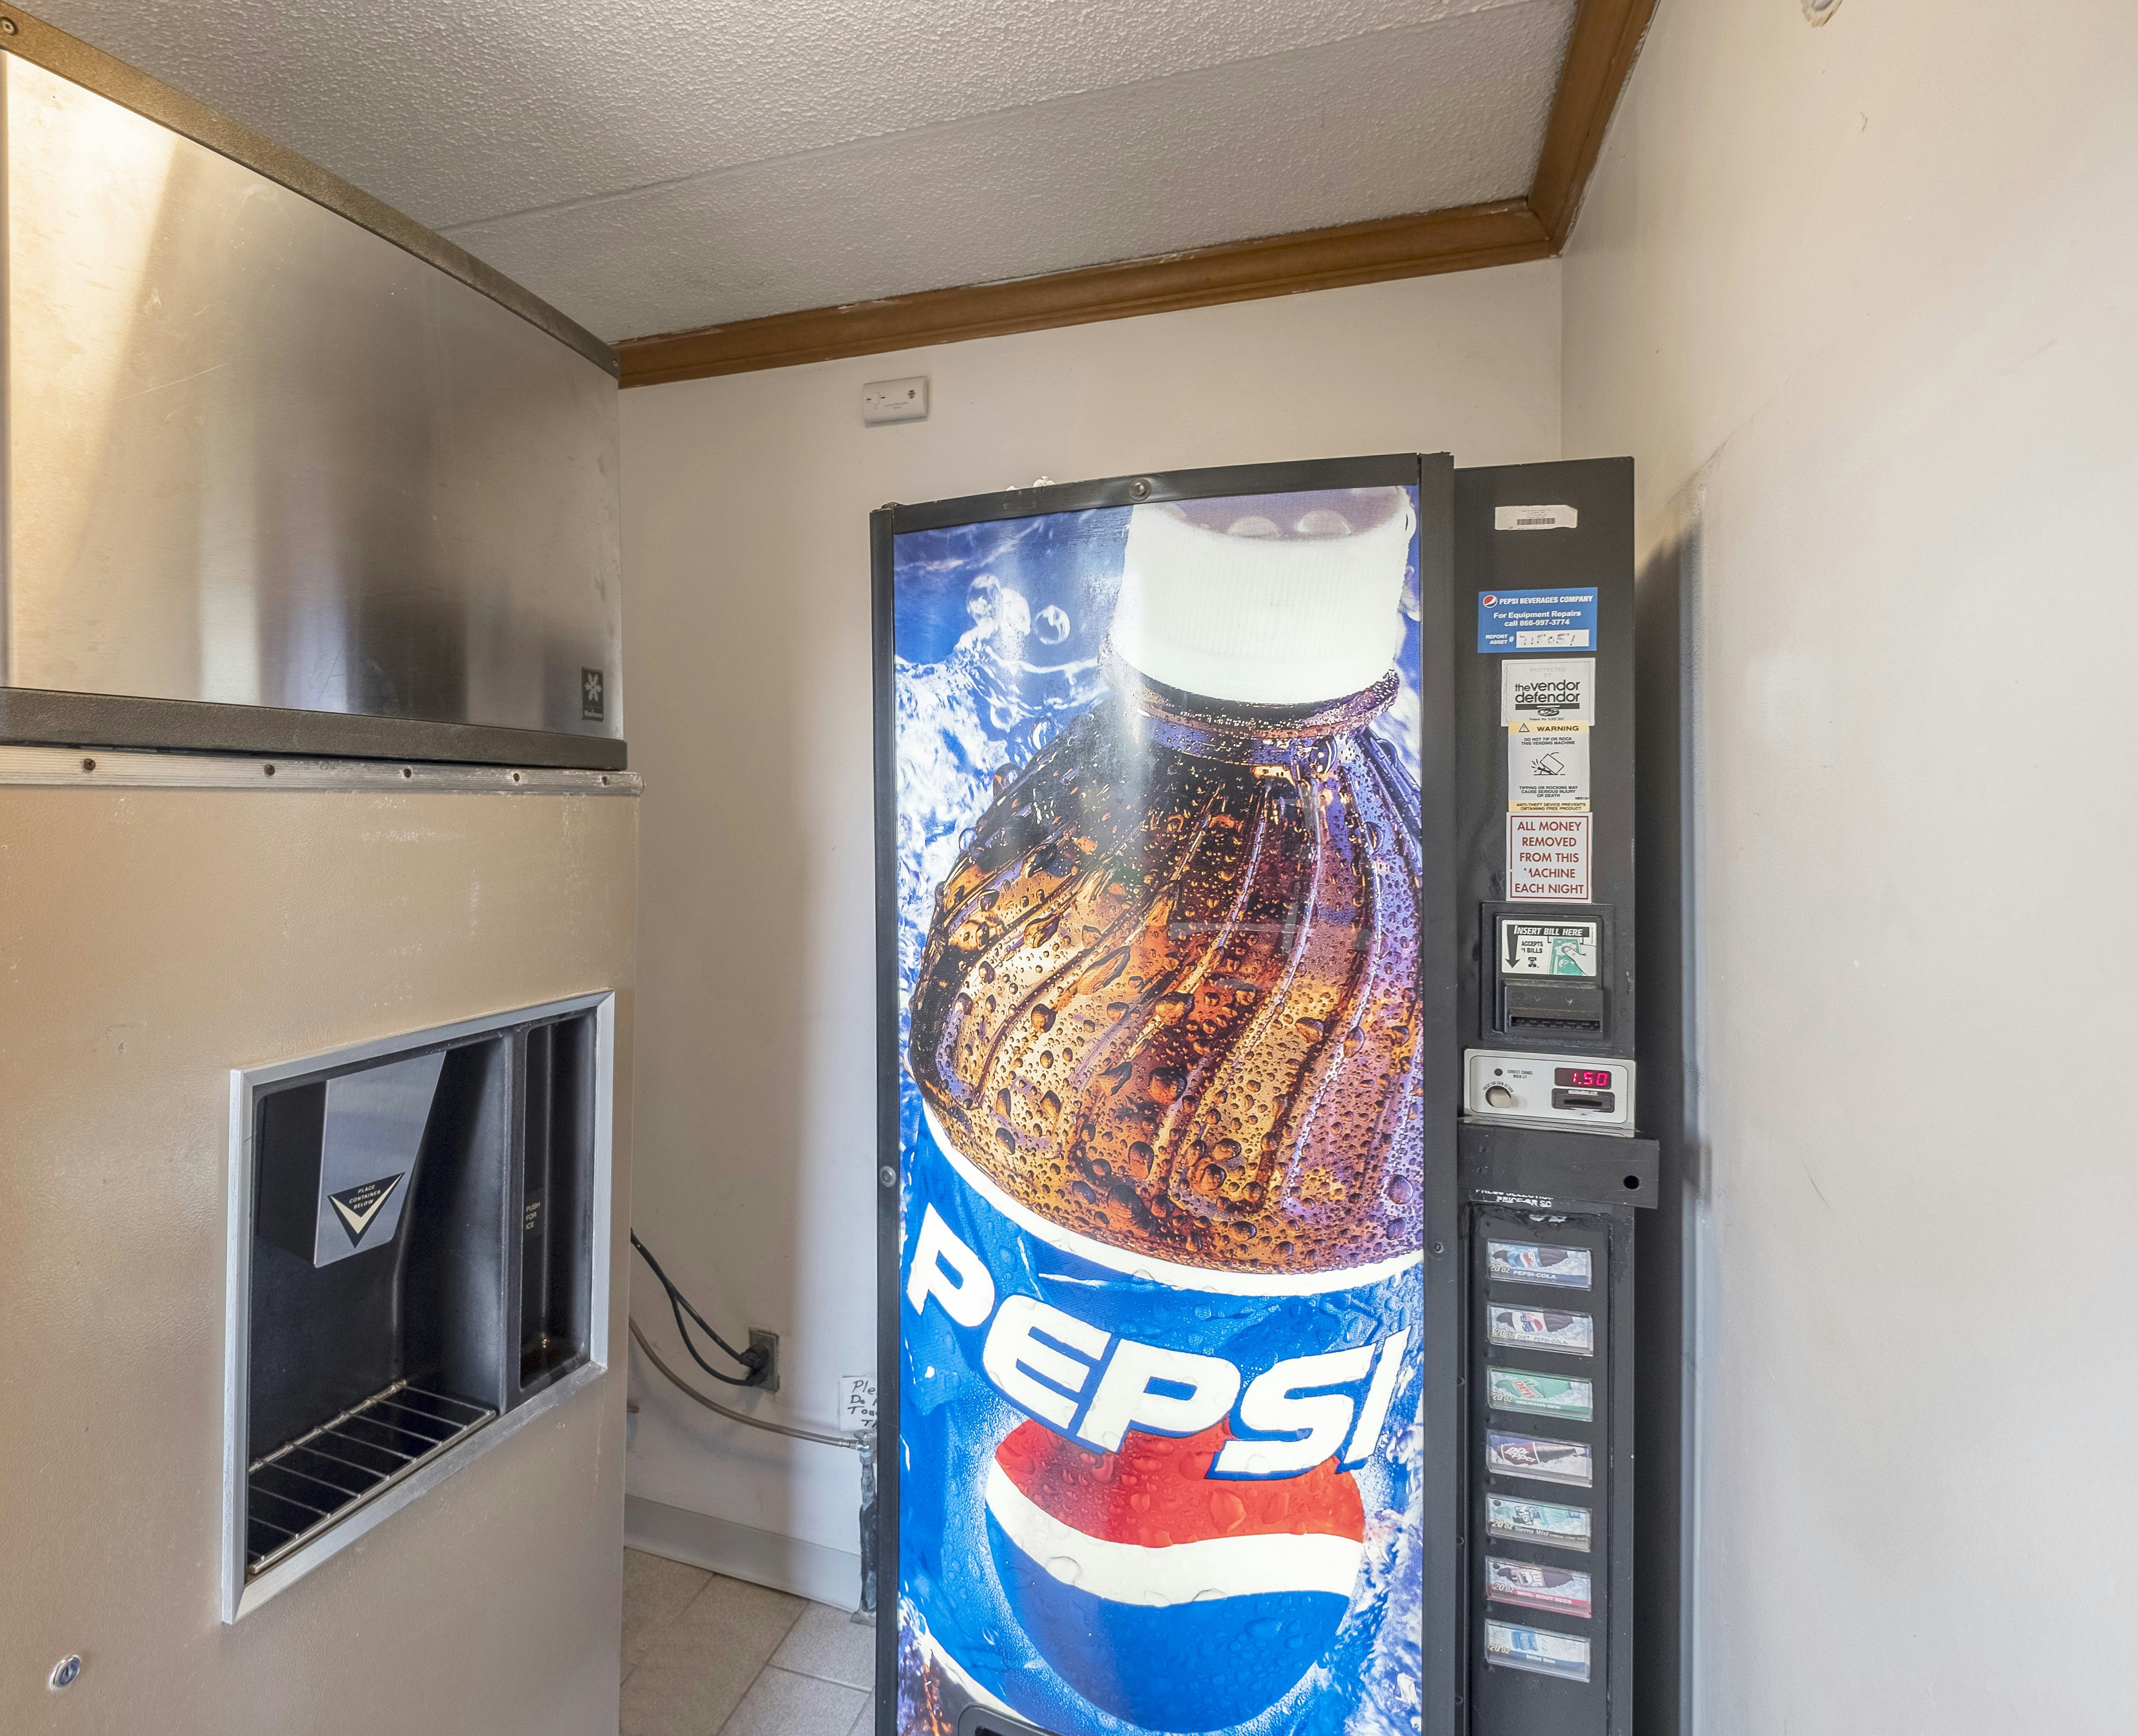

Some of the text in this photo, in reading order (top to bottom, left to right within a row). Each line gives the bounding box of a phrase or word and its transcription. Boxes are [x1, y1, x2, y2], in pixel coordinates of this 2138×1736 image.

[1560, 595, 1593, 603] COMPANY
[1515, 691, 1580, 703] defendor
[1517, 821, 1582, 831] ALL MONEY
[1522, 837, 1576, 847] REMOVED
[1520, 852, 1579, 863] FROM THIS
[1515, 883, 1584, 894] EACH NIGHT
[1514, 925, 1542, 934] INSERT
[1572, 1071, 1608, 1085] 1.50
[358, 1184, 375, 1194] PLACE
[349, 1190, 381, 1203] CONTAINER
[353, 1199, 374, 1209] BELOW
[526, 1202, 540, 1212] PUSH
[525, 1212, 537, 1221] FOR
[525, 1221, 534, 1230] ICE
[1490, 1263, 1501, 1272] 20
[1513, 1270, 1557, 1279] PEPSI-COLA
[1494, 1328, 1506, 1337] 20
[906, 1203, 1410, 1474] PEPSI
[852, 1380, 877, 1395] Ple
[850, 1395, 865, 1404] Do
[1492, 1392, 1503, 1401] 20
[1504, 1447, 1537, 1463] Pepper
[1491, 1519, 1504, 1528] 20
[1514, 1526, 1534, 1534] Sierra
[1493, 1583, 1505, 1591] 20
[1489, 1644, 1501, 1652] 20
